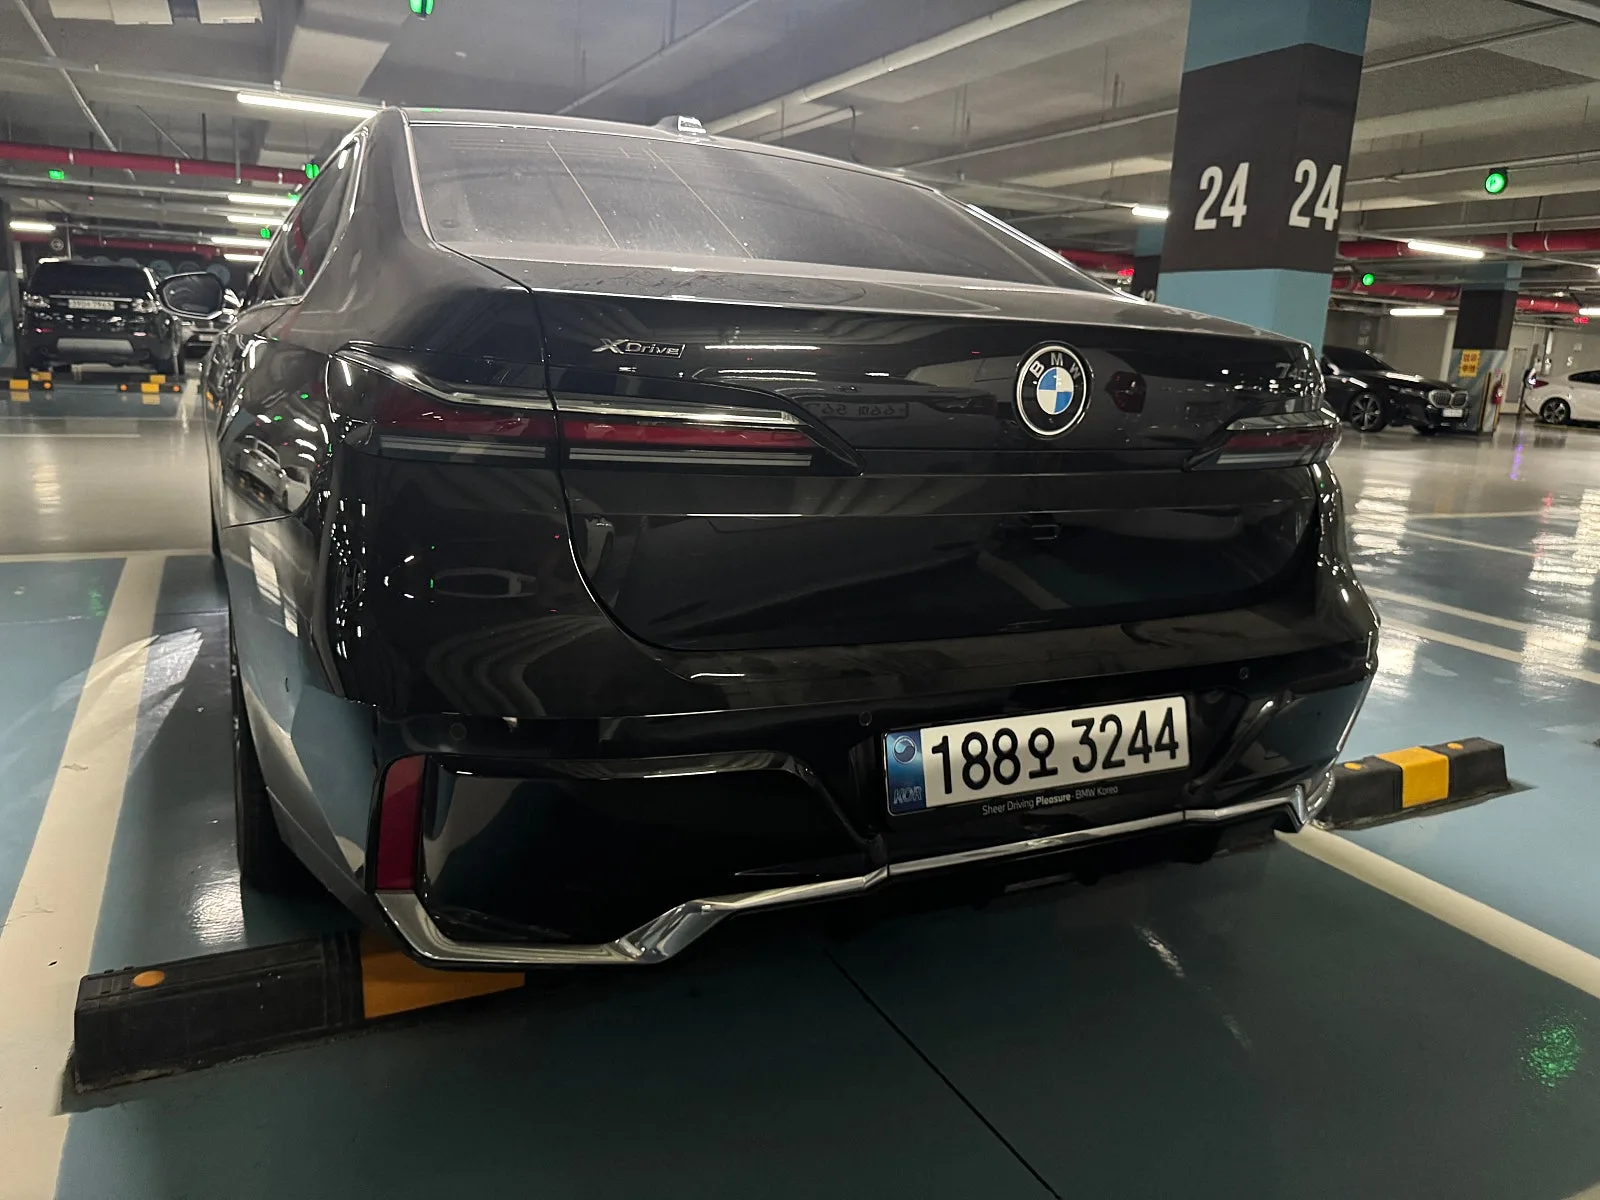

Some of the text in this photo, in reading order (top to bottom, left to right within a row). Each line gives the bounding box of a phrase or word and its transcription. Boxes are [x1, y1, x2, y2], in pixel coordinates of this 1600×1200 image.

[1194, 162, 1250, 231] 24
[1288, 158, 1342, 231] 24
[1029, 351, 1082, 381] BMW
[931, 706, 1179, 795] 188오 3244
[893, 785, 923, 805] KOR
[982, 785, 1119, 815] Sheer Driving Pleasure BMW Korea
